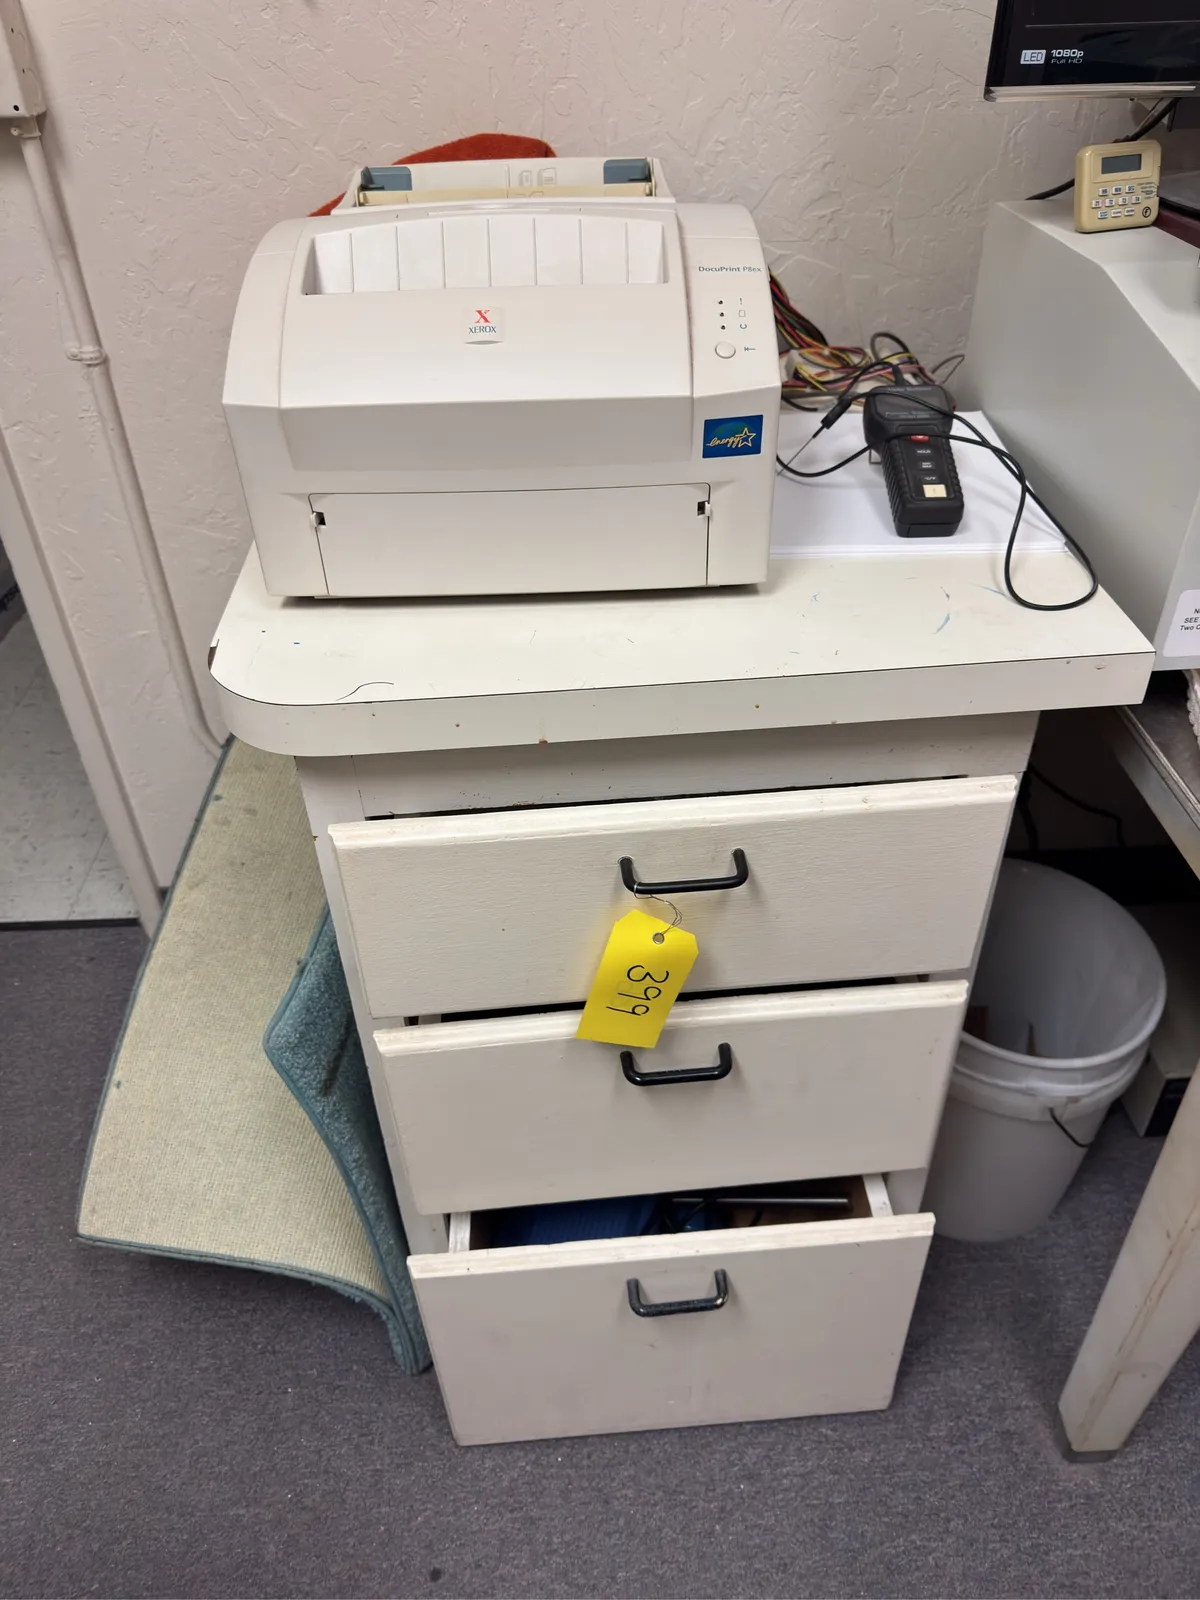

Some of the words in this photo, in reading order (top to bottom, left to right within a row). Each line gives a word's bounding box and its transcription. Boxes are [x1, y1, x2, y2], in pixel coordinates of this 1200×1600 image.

[1024, 52, 1043, 62] LED
[1051, 49, 1084, 58] 1080p
[475, 309, 491, 324] X
[468, 325, 496, 334] XEROX
[605, 964, 670, 1016] 399
